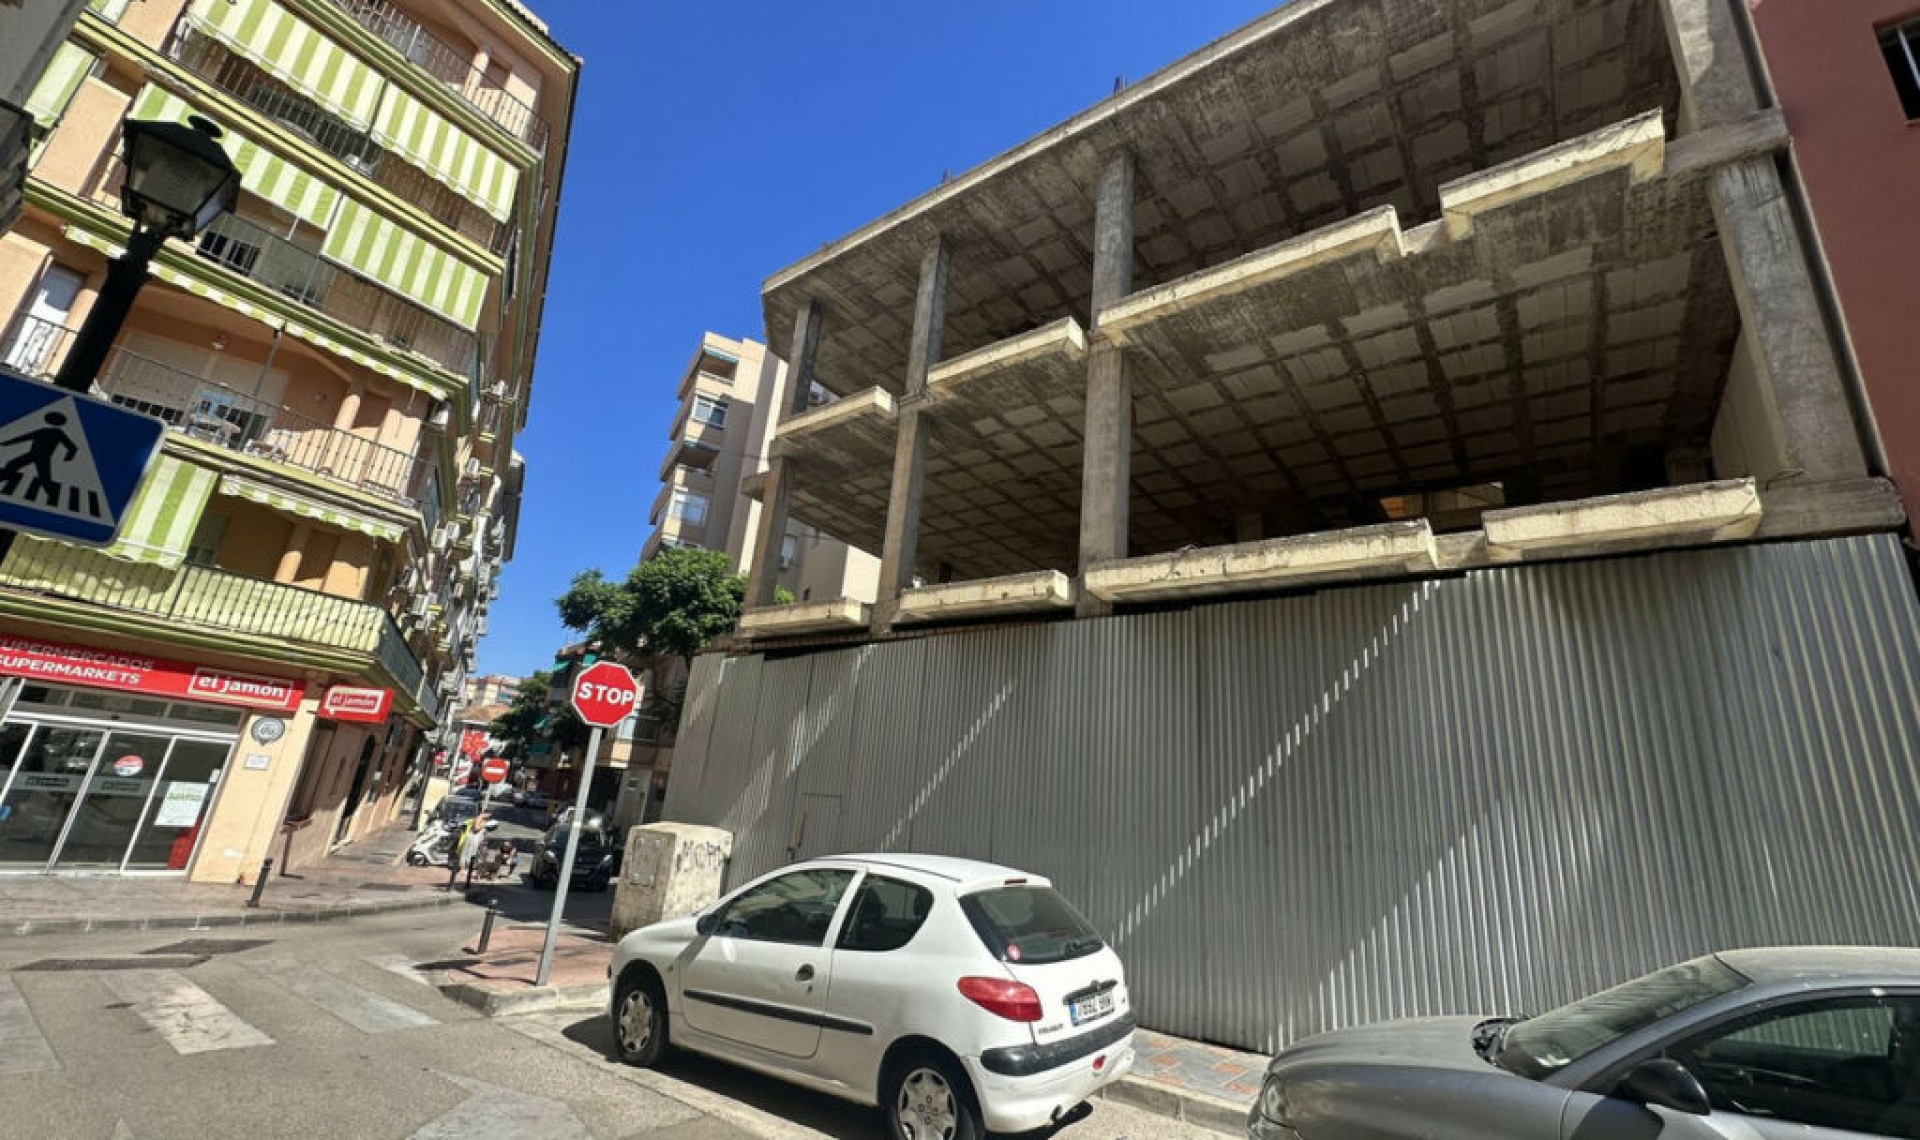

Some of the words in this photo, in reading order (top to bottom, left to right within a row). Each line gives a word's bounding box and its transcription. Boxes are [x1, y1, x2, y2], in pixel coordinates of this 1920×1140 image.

[198, 674, 218, 689] el
[332, 693, 342, 704] el
[578, 682, 634, 705] STOP
